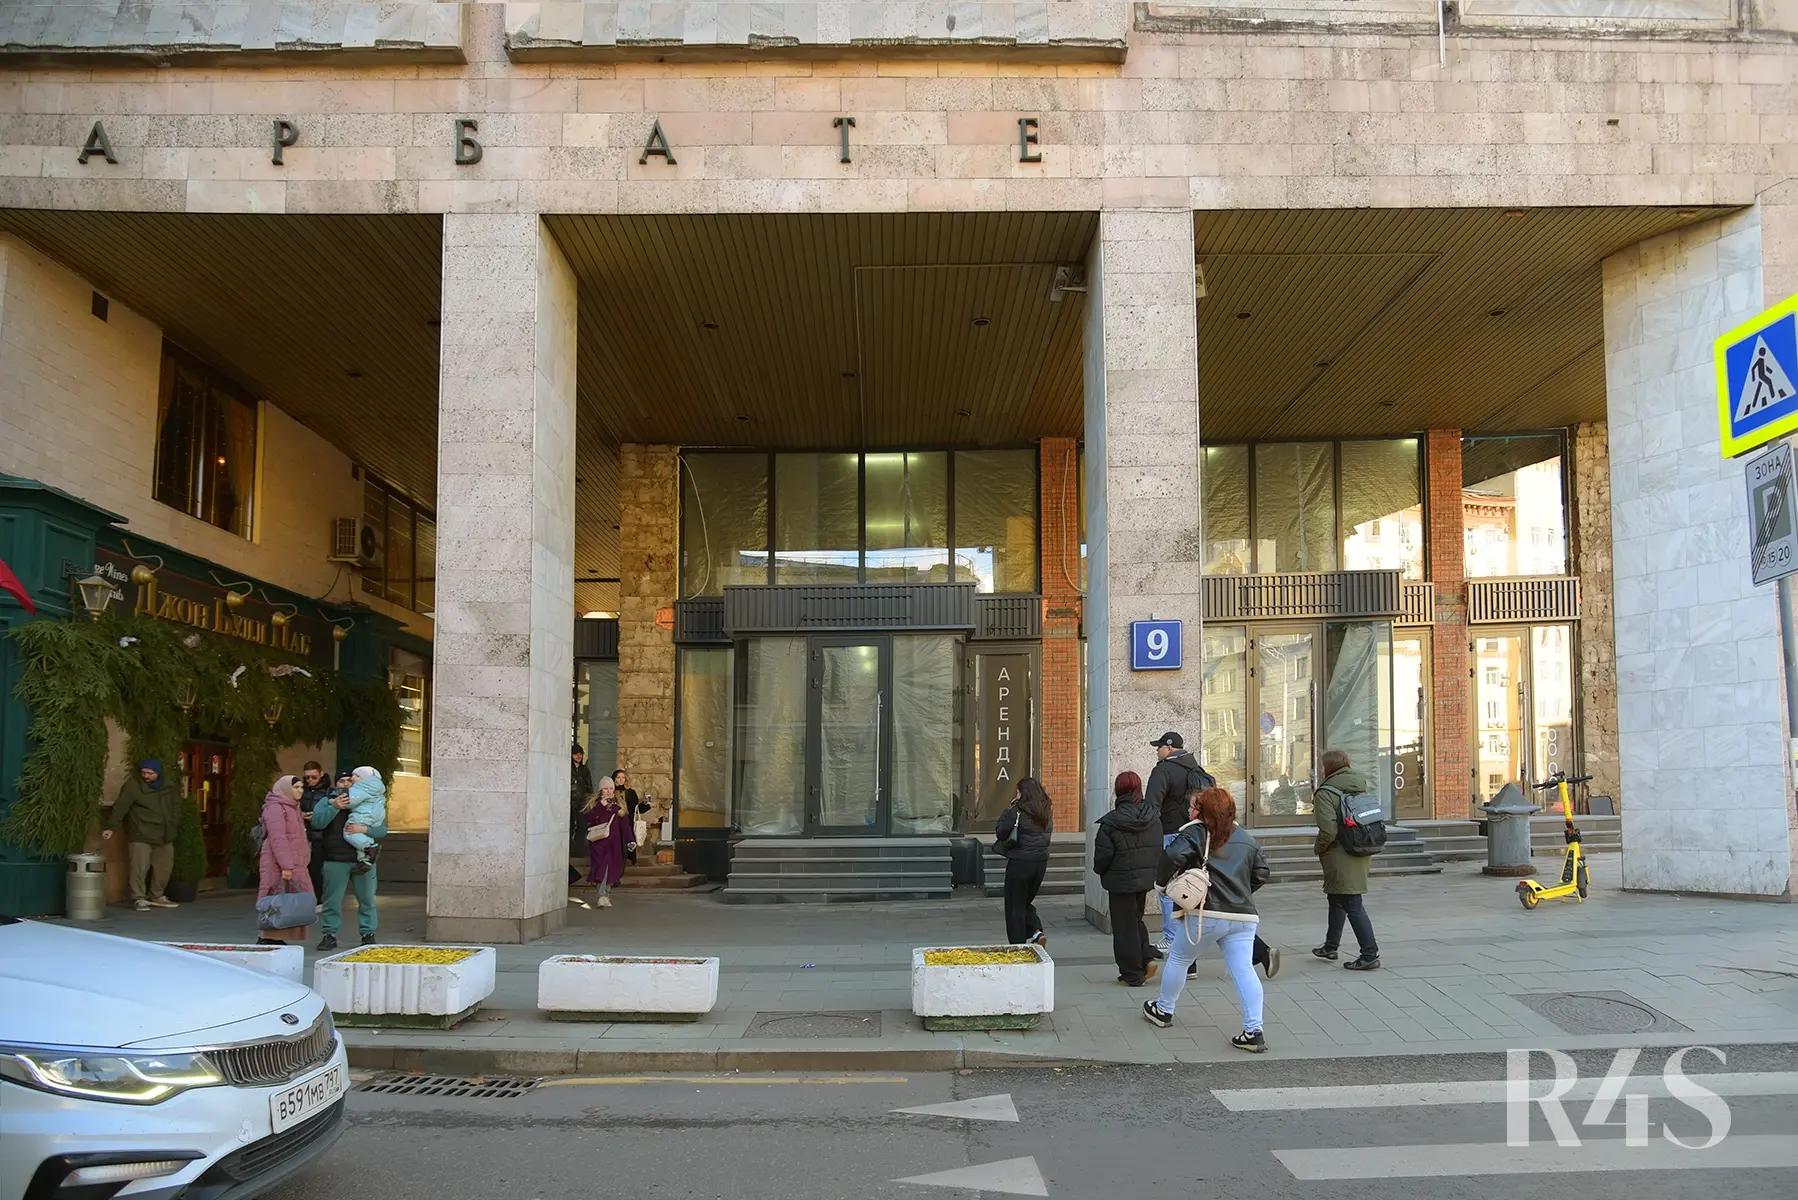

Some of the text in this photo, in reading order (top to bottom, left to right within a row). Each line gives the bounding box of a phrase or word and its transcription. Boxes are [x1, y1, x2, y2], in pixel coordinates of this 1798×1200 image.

[1755, 455, 1782, 480] ЗОНА
[1768, 550, 1776, 564] 15
[1778, 545, 1790, 562] 20
[1147, 629, 1169, 660] 9
[997, 667, 1010, 781] АРЕНДА
